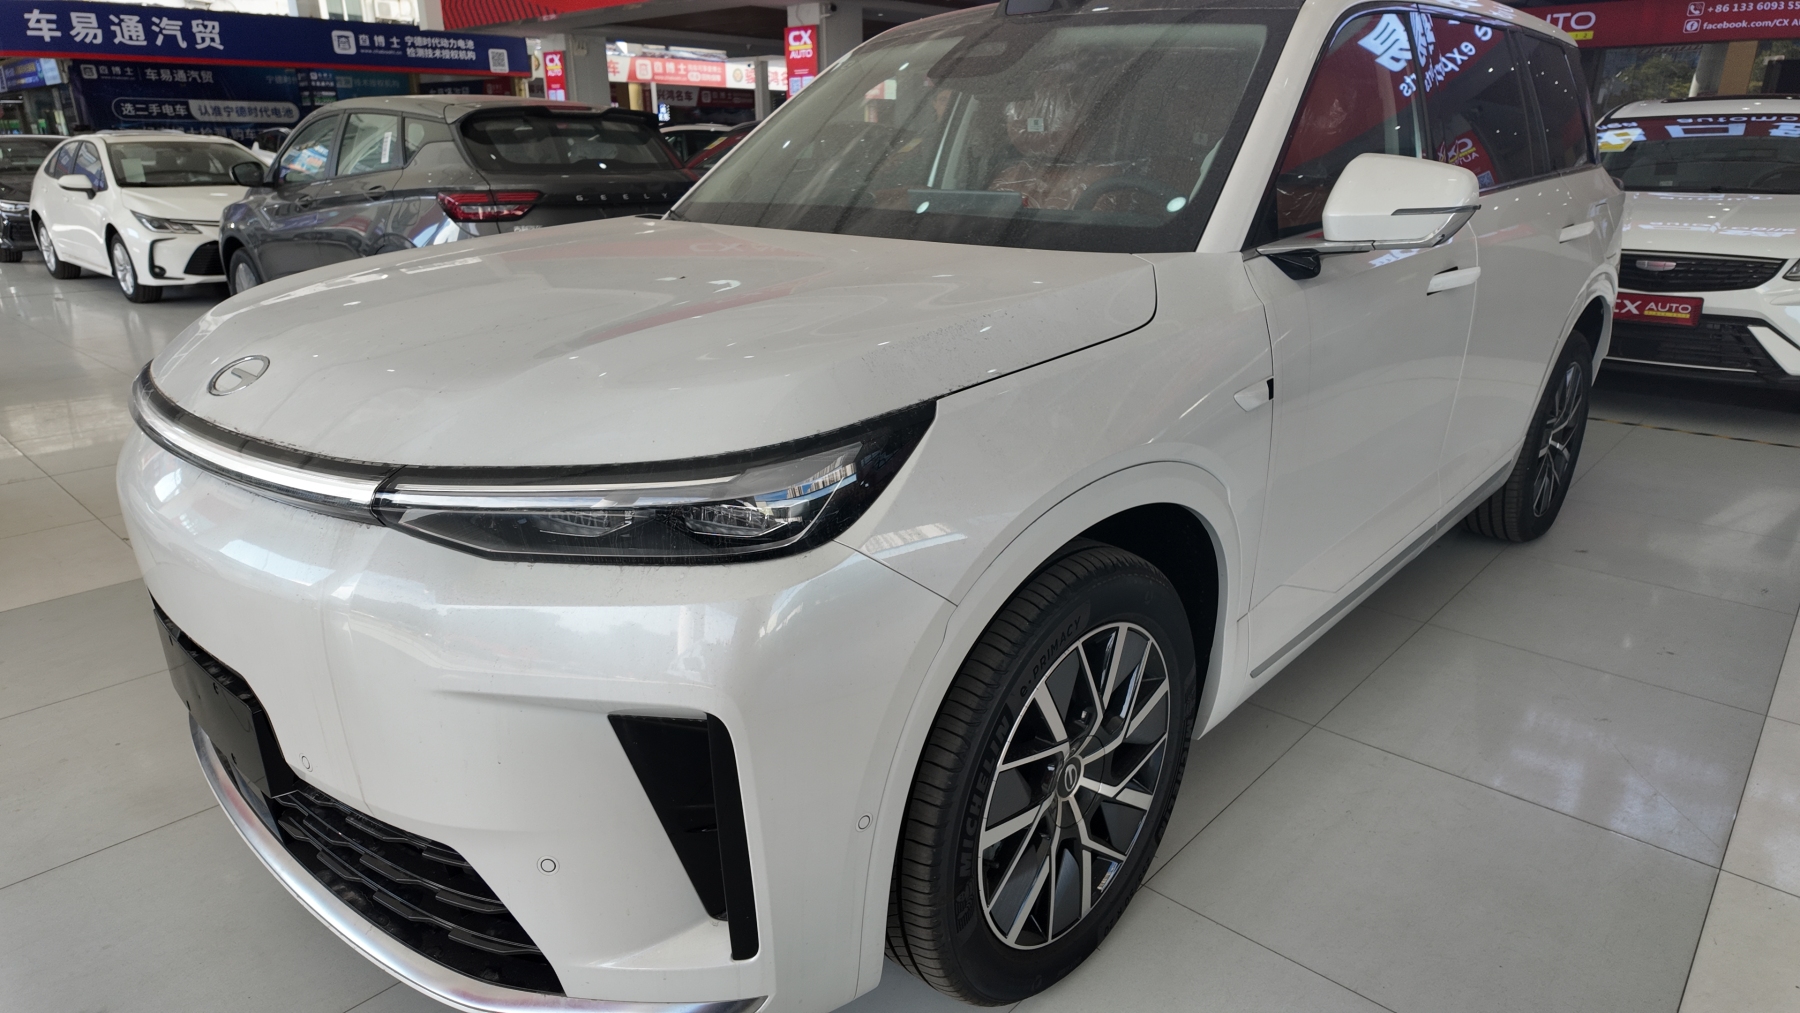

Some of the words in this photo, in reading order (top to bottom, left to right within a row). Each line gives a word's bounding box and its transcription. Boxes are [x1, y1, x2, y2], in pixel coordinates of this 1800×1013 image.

[1708, 4, 1730, 13] +86
[1732, 3, 1754, 12] 133
[1756, 2, 1785, 11] 6093
[24, 9, 224, 50] 车易通汽贸
[404, 36, 475, 49] 宁德时代动力电池
[788, 30, 812, 46] CX
[406, 47, 476, 60] 检测技术授权机构
[546, 54, 561, 66] CX
[790, 49, 813, 59] AUTO
[144, 67, 214, 83] 车易通汽贸
[548, 68, 562, 76] AUTO
[120, 103, 188, 116] 选二手电车
[199, 105, 294, 119] 认准宁德时代电池
[575, 192, 668, 202] GEELY
[1645, 302, 1692, 314] AUTO
[959, 702, 1013, 879] MICHELIN
